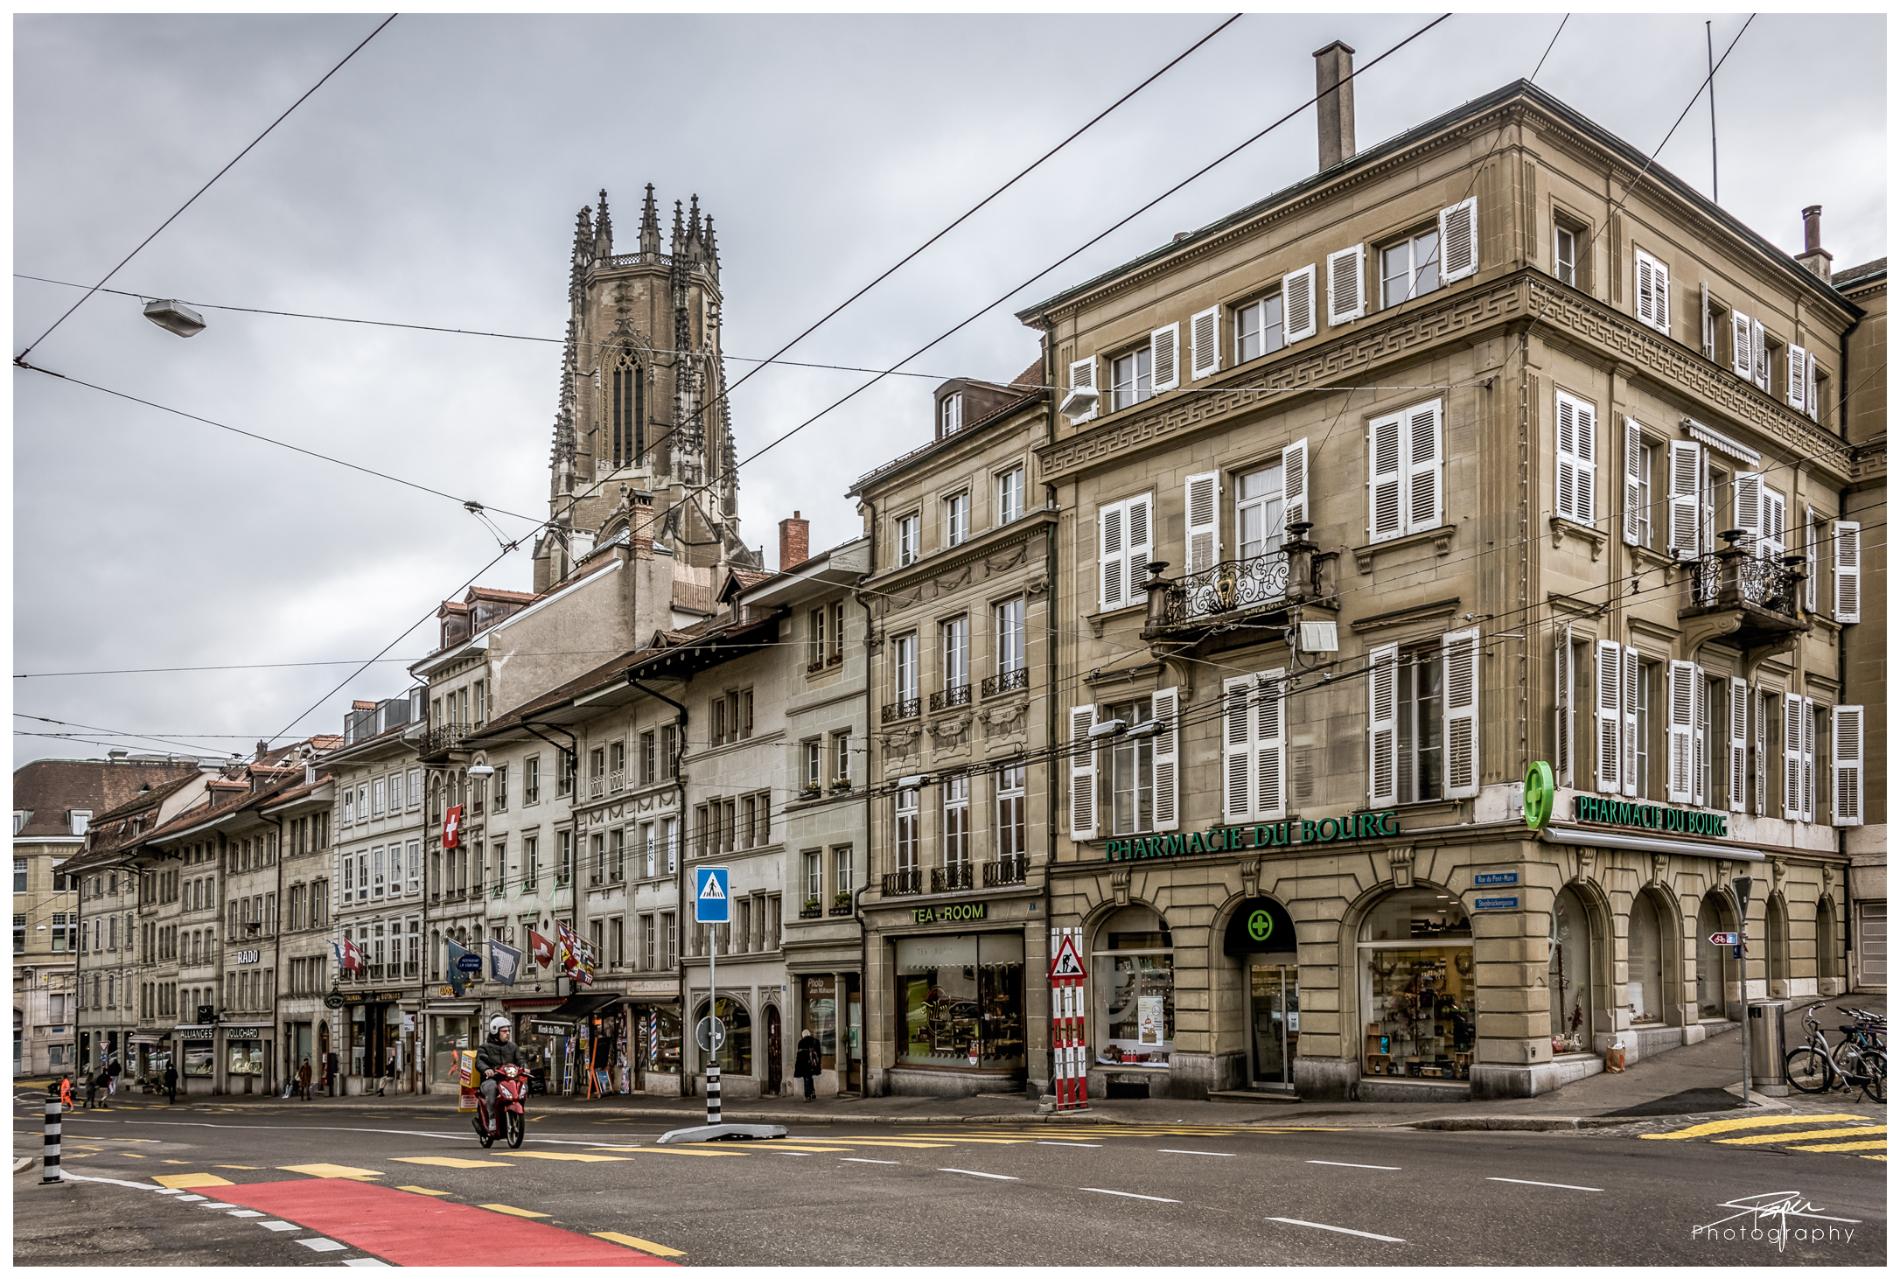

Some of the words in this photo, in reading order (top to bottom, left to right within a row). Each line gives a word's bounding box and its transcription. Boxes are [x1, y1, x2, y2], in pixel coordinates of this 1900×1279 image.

[1579, 796, 1661, 829] PHARMACIE
[1667, 808, 1685, 832] DU
[1688, 811, 1728, 836] BOURG
[1105, 827, 1244, 861] PHARMACIE
[1254, 822, 1290, 847] DU
[1301, 811, 1399, 843] BOURG
[237, 950, 258, 964] RADO
[808, 978, 824, 987] Photo
[180, 1029, 213, 1039] ALLIANCES
